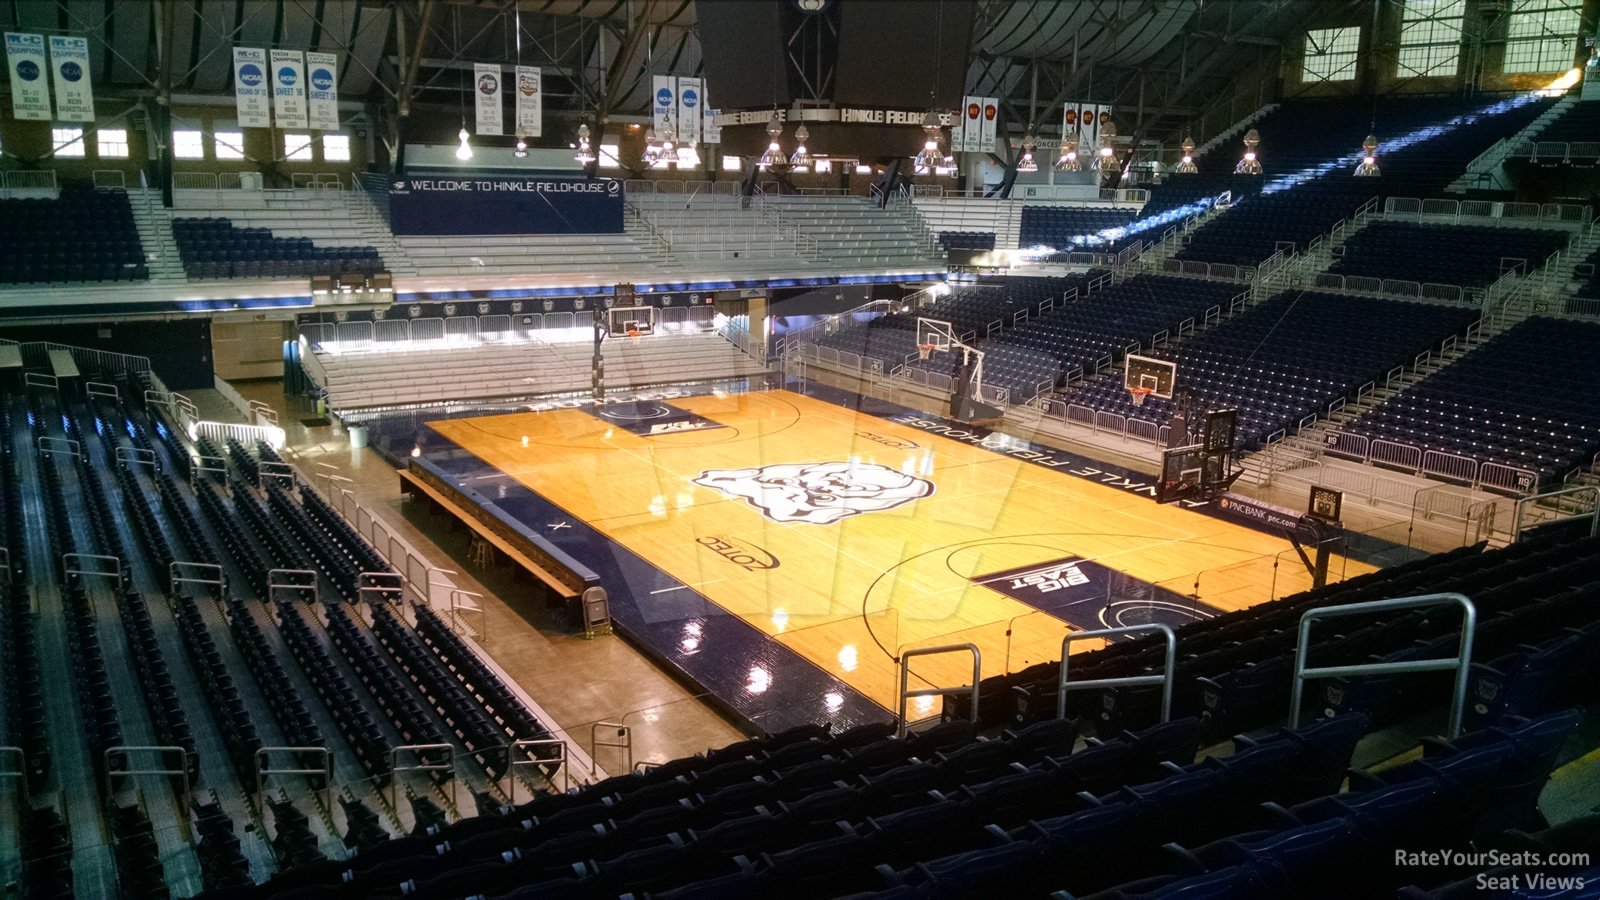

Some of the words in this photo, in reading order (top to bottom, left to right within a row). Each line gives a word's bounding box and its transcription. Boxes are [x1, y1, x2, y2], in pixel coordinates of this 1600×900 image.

[276, 88, 293, 96] SWEET
[841, 108, 883, 122] HINKLE
[411, 180, 472, 191] WELCOME
[475, 181, 491, 191] TO
[494, 181, 535, 192] HINKLE
[537, 182, 604, 193] FIELDHOUSE
[1519, 477, 1530, 487] 119
[1267, 515, 1297, 529] pnc.com
[1010, 566, 1082, 590] EAST
[1037, 573, 1091, 593] BIG
